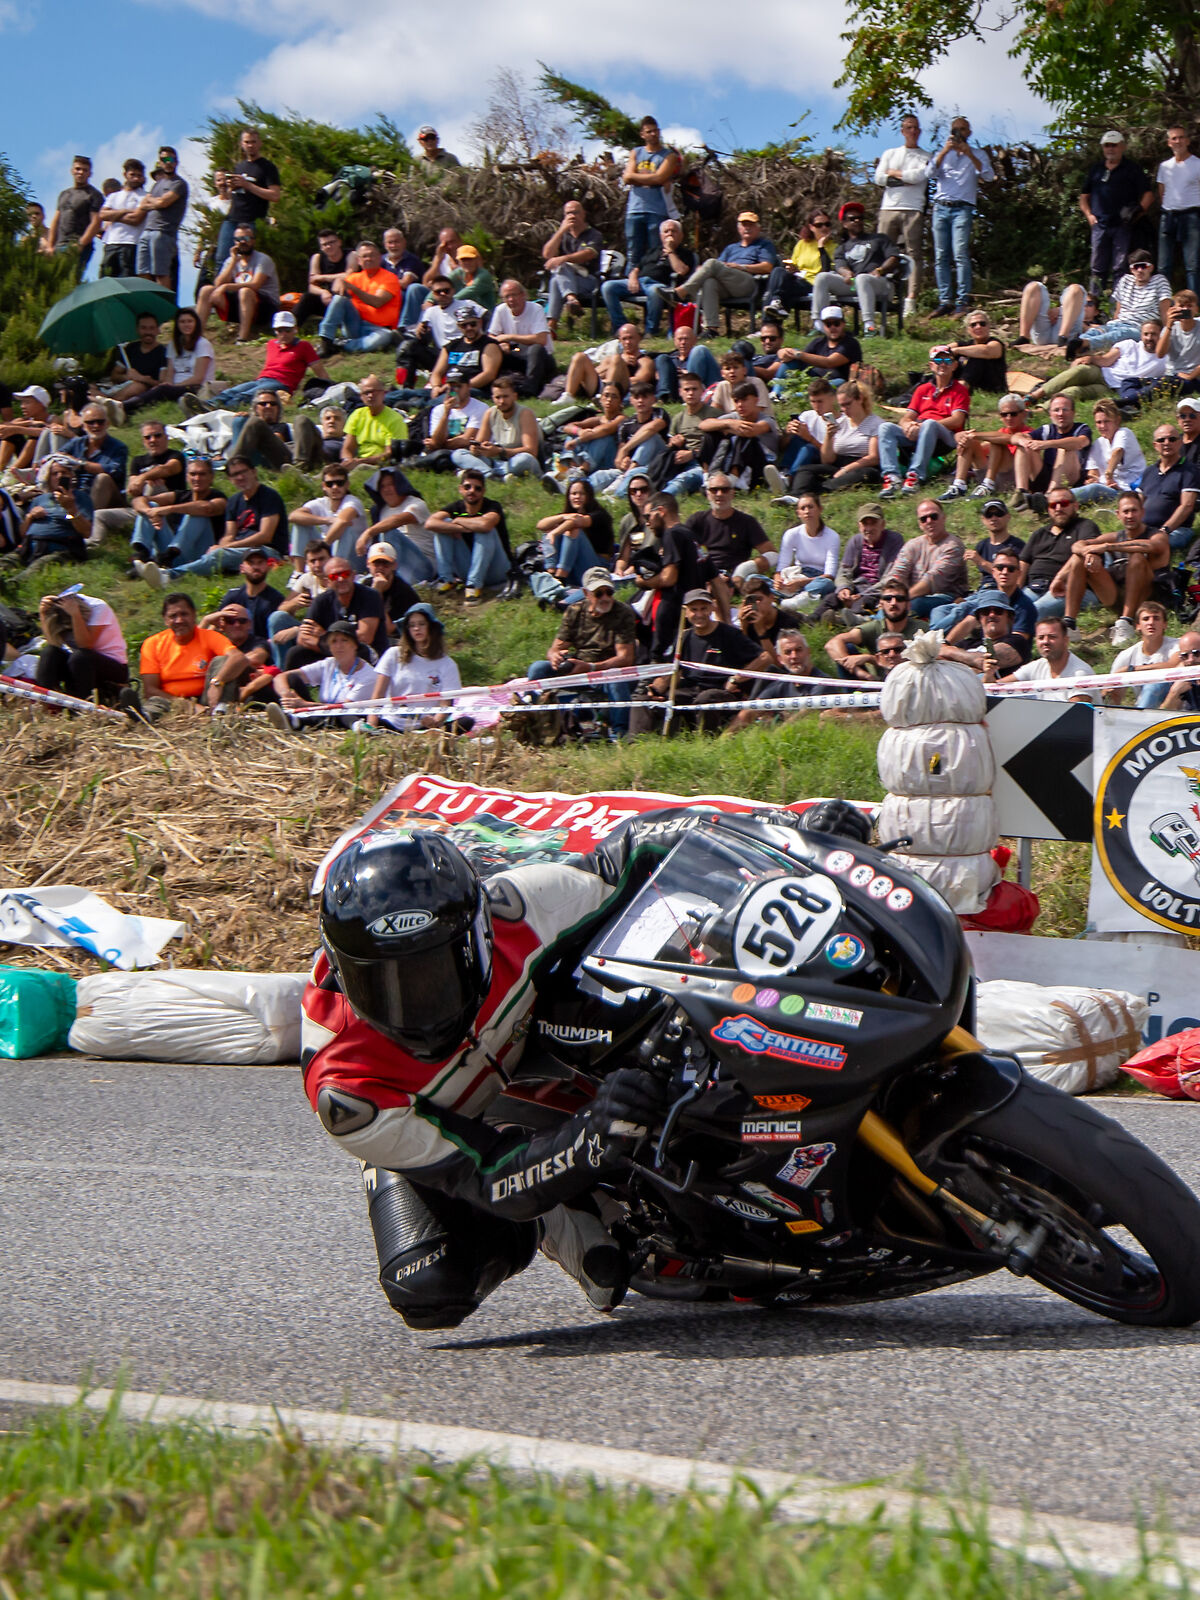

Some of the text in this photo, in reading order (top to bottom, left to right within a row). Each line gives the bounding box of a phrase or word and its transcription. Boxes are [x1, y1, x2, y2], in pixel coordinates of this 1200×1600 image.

[413, 780, 639, 840] TUTTI PAZ
[381, 914, 427, 934] X-lite
[741, 883, 832, 968] 528
[537, 1020, 613, 1044] TRIUMPH
[716, 1017, 847, 1062] RENTHAL
[742, 1121, 801, 1133] MANICI
